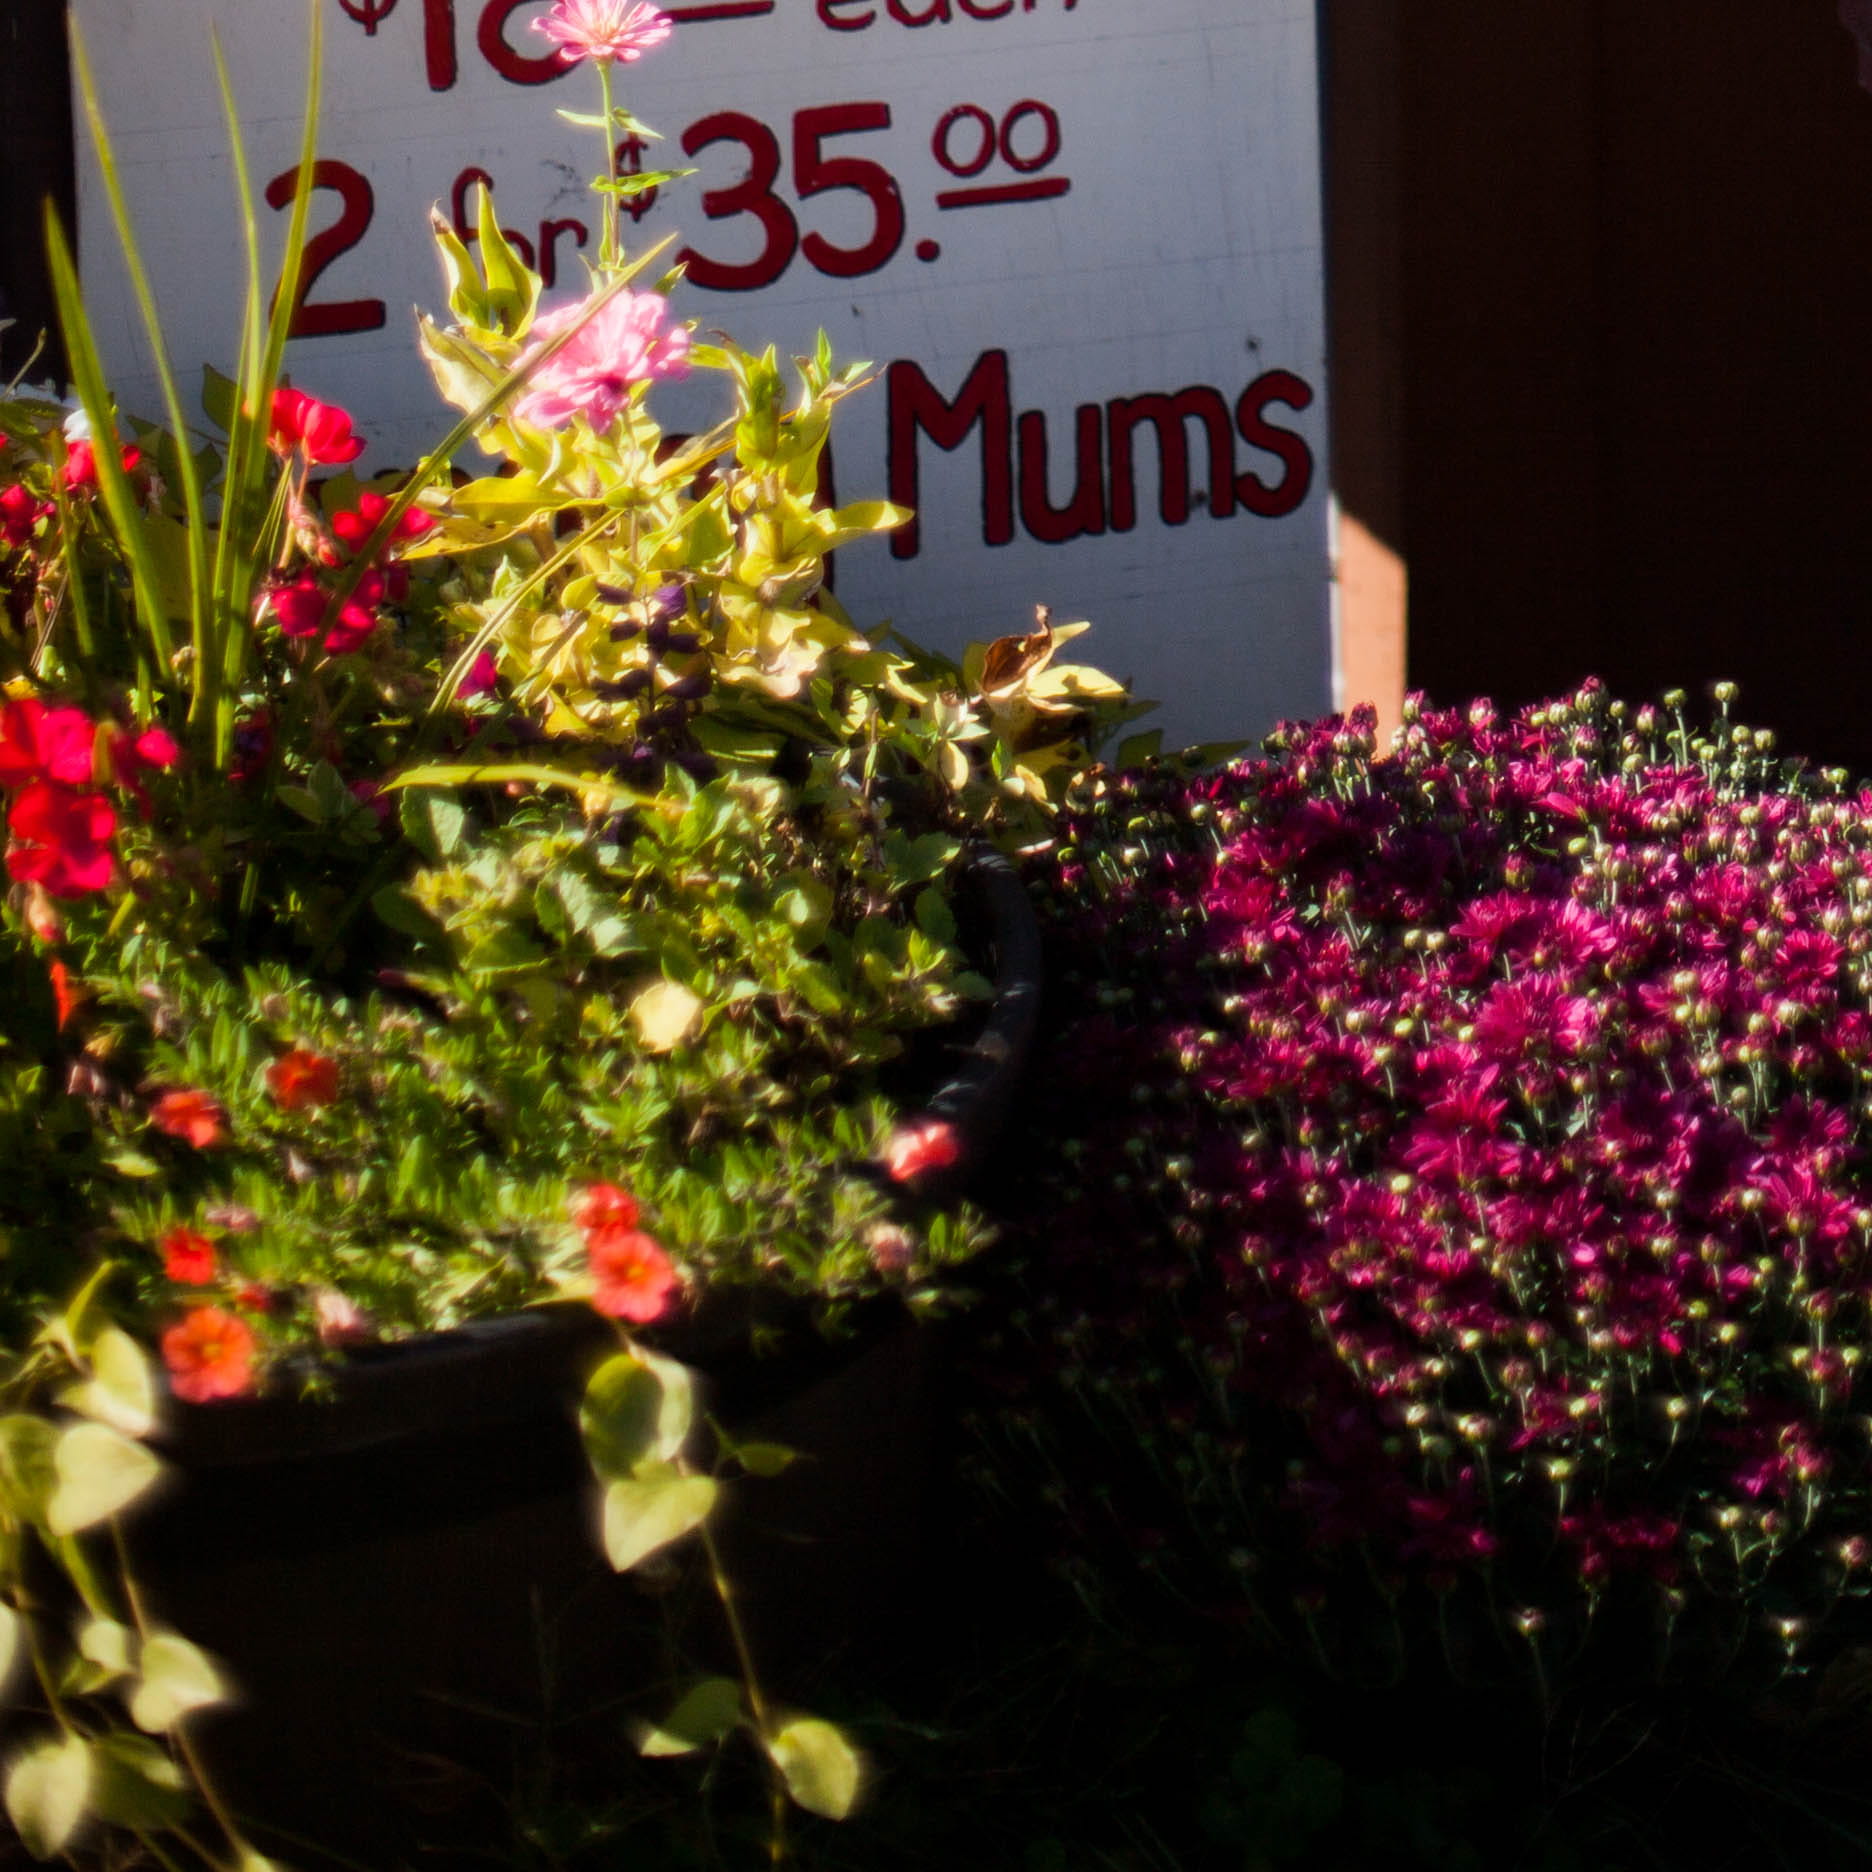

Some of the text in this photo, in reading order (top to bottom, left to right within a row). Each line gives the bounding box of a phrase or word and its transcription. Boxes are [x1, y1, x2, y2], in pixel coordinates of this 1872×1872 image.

[264, 157, 386, 339] 2
[612, 97, 1071, 291] $35.00
[886, 349, 1313, 560] Mums
